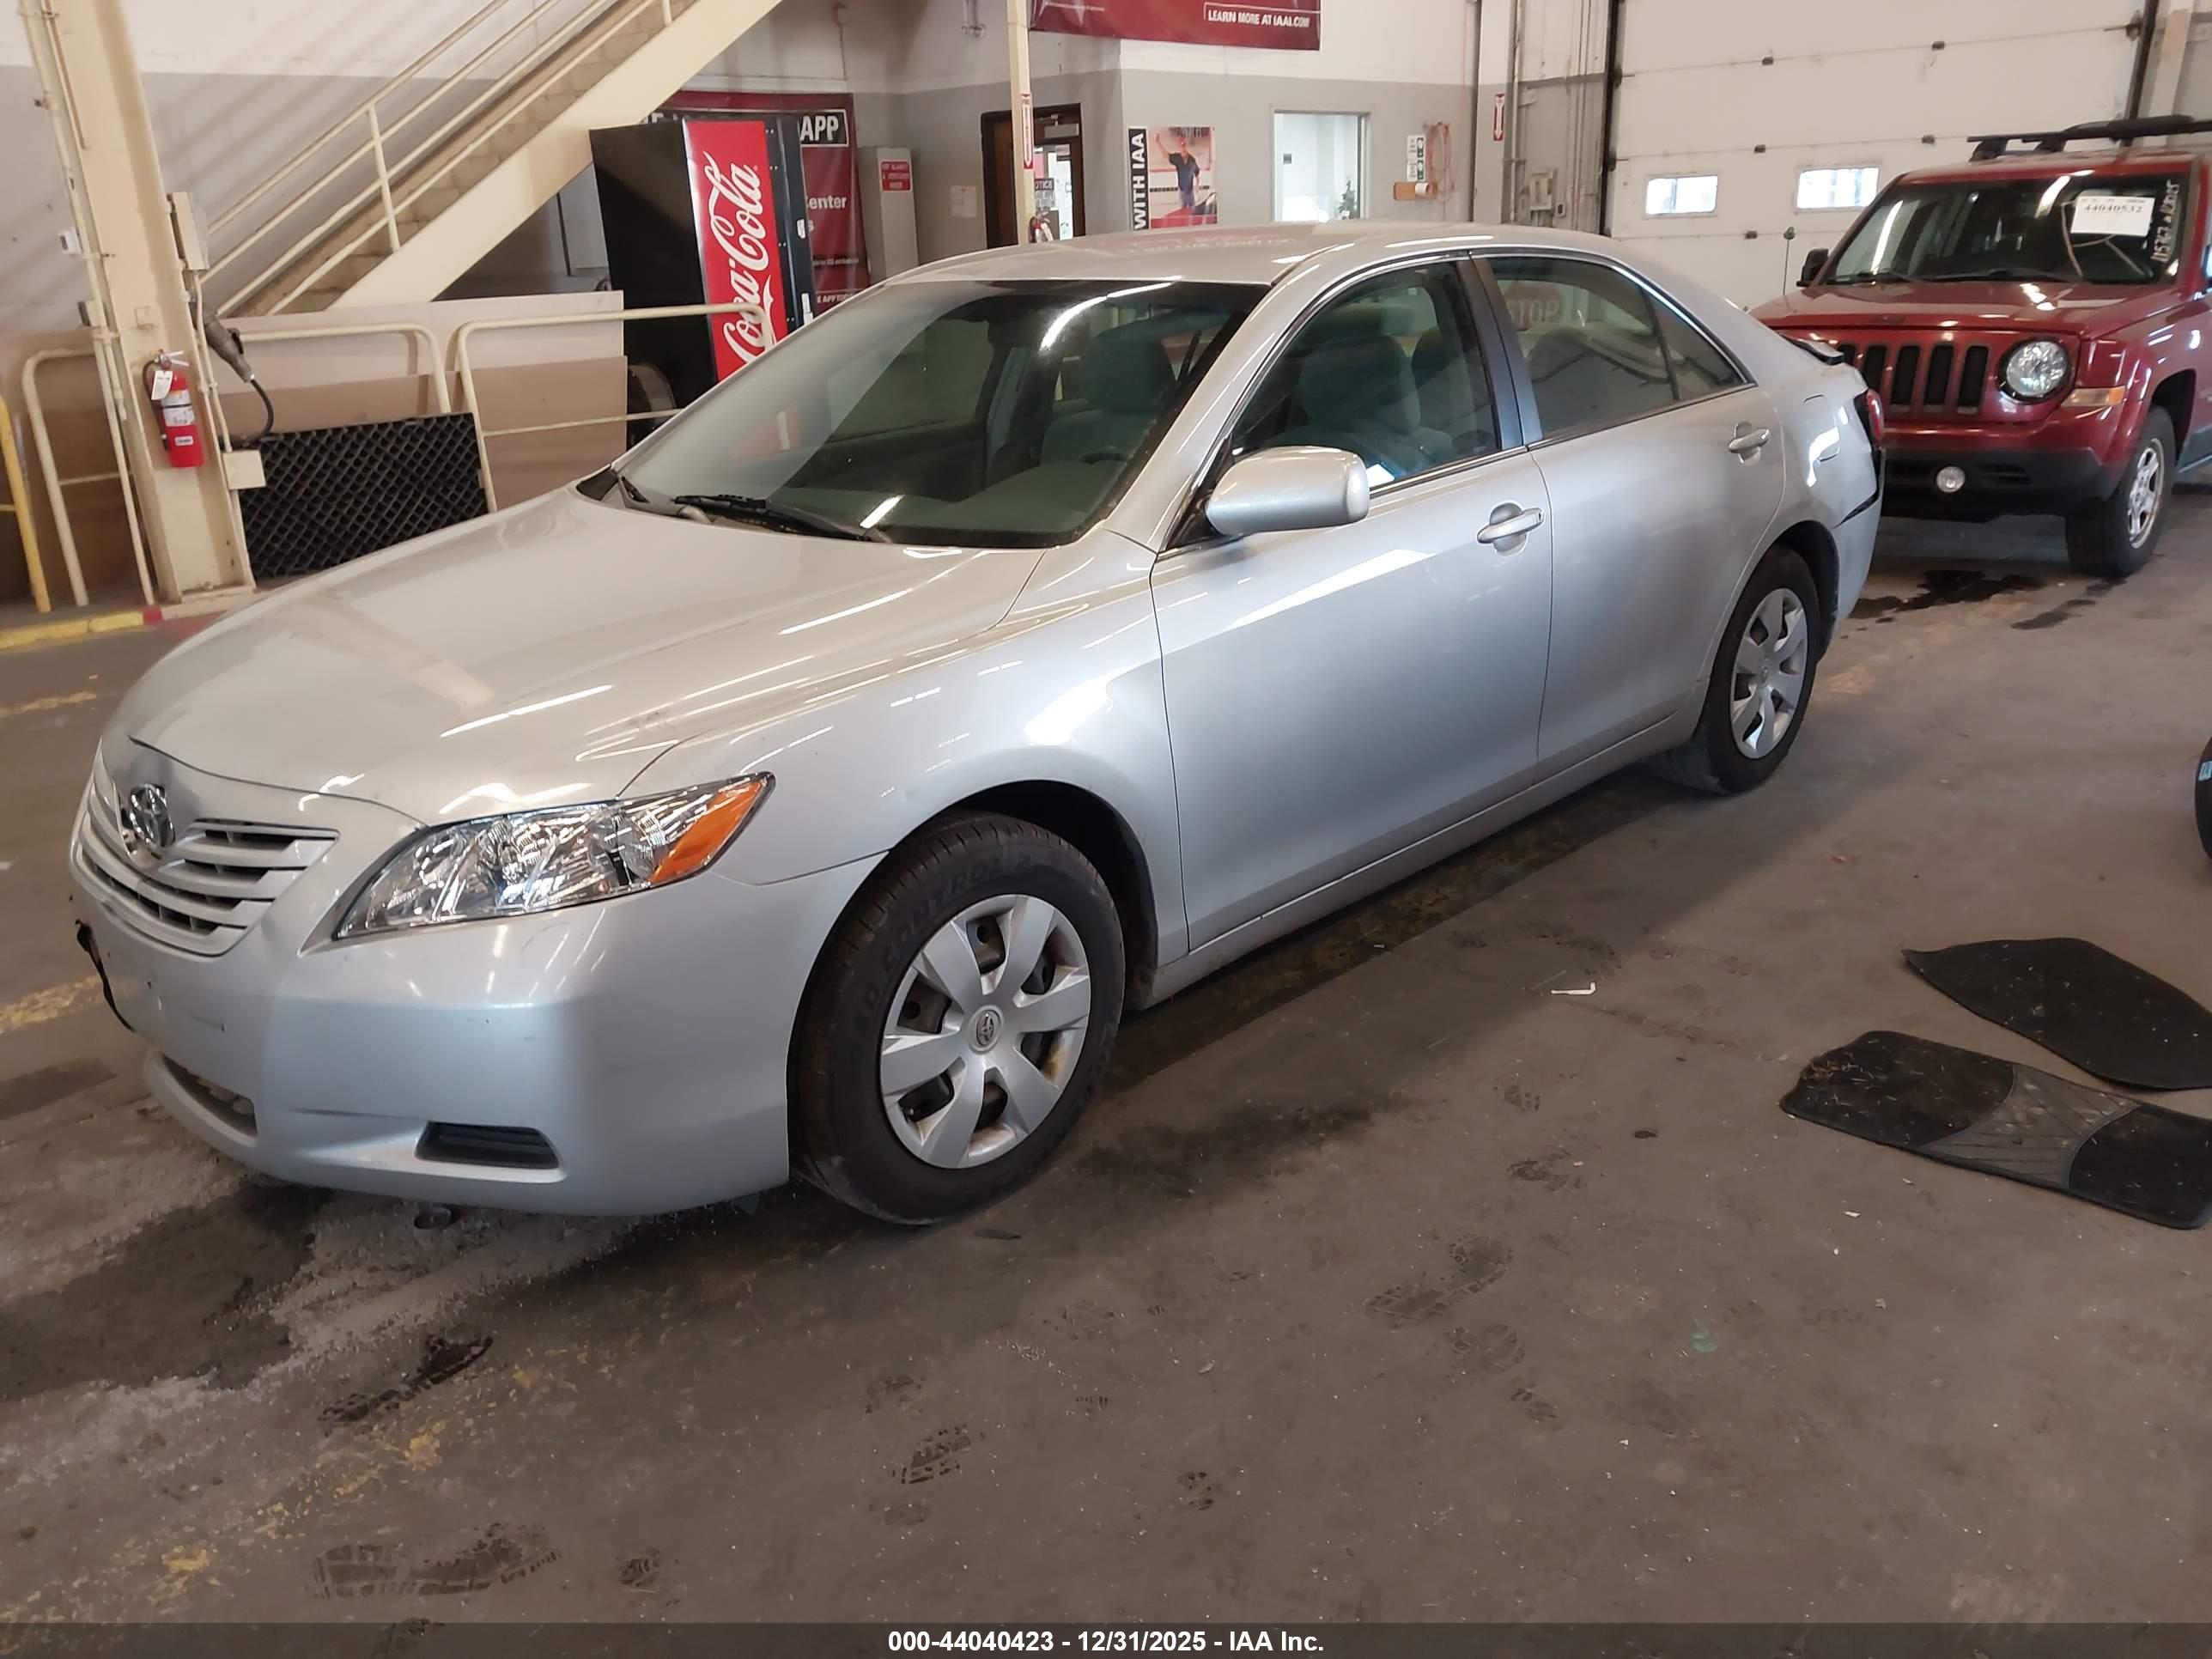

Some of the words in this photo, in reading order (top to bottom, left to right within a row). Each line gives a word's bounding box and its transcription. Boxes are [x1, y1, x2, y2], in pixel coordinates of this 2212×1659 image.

[1208, 9, 1237, 23] LEARN
[1238, 12, 1260, 25] MORE
[1261, 15, 1272, 26] AT
[799, 115, 839, 142] APP
[1131, 133, 1146, 169] IAA
[1035, 180, 1054, 189] OTICE
[807, 196, 847, 210] enter
[1133, 175, 1147, 230] WITH
